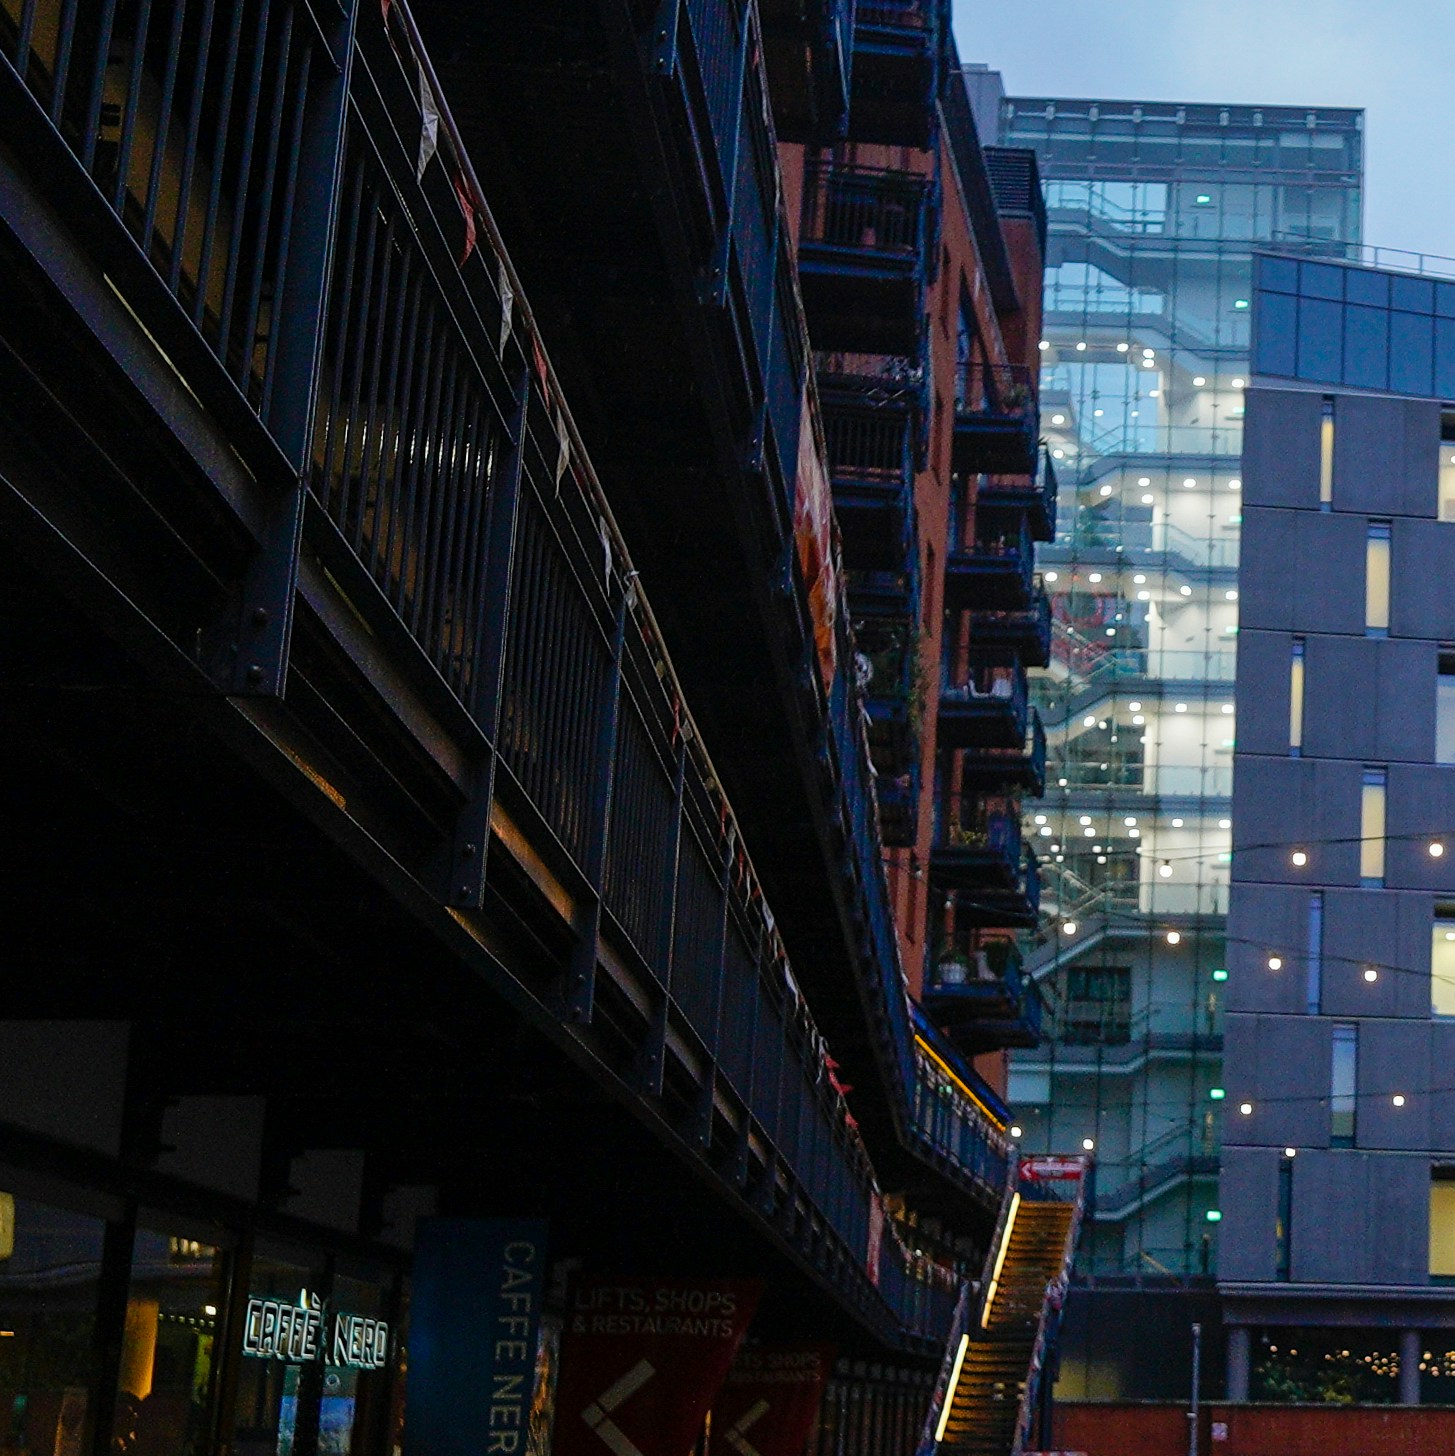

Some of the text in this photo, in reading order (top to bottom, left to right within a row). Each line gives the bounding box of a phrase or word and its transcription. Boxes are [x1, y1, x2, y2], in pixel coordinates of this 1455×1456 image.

[494, 1240, 537, 1361] CAFFE
[573, 1286, 737, 1317] LIFTS, SHOPS
[333, 1312, 390, 1370] NERO
[572, 1314, 734, 1339] & RESTAURANTS
